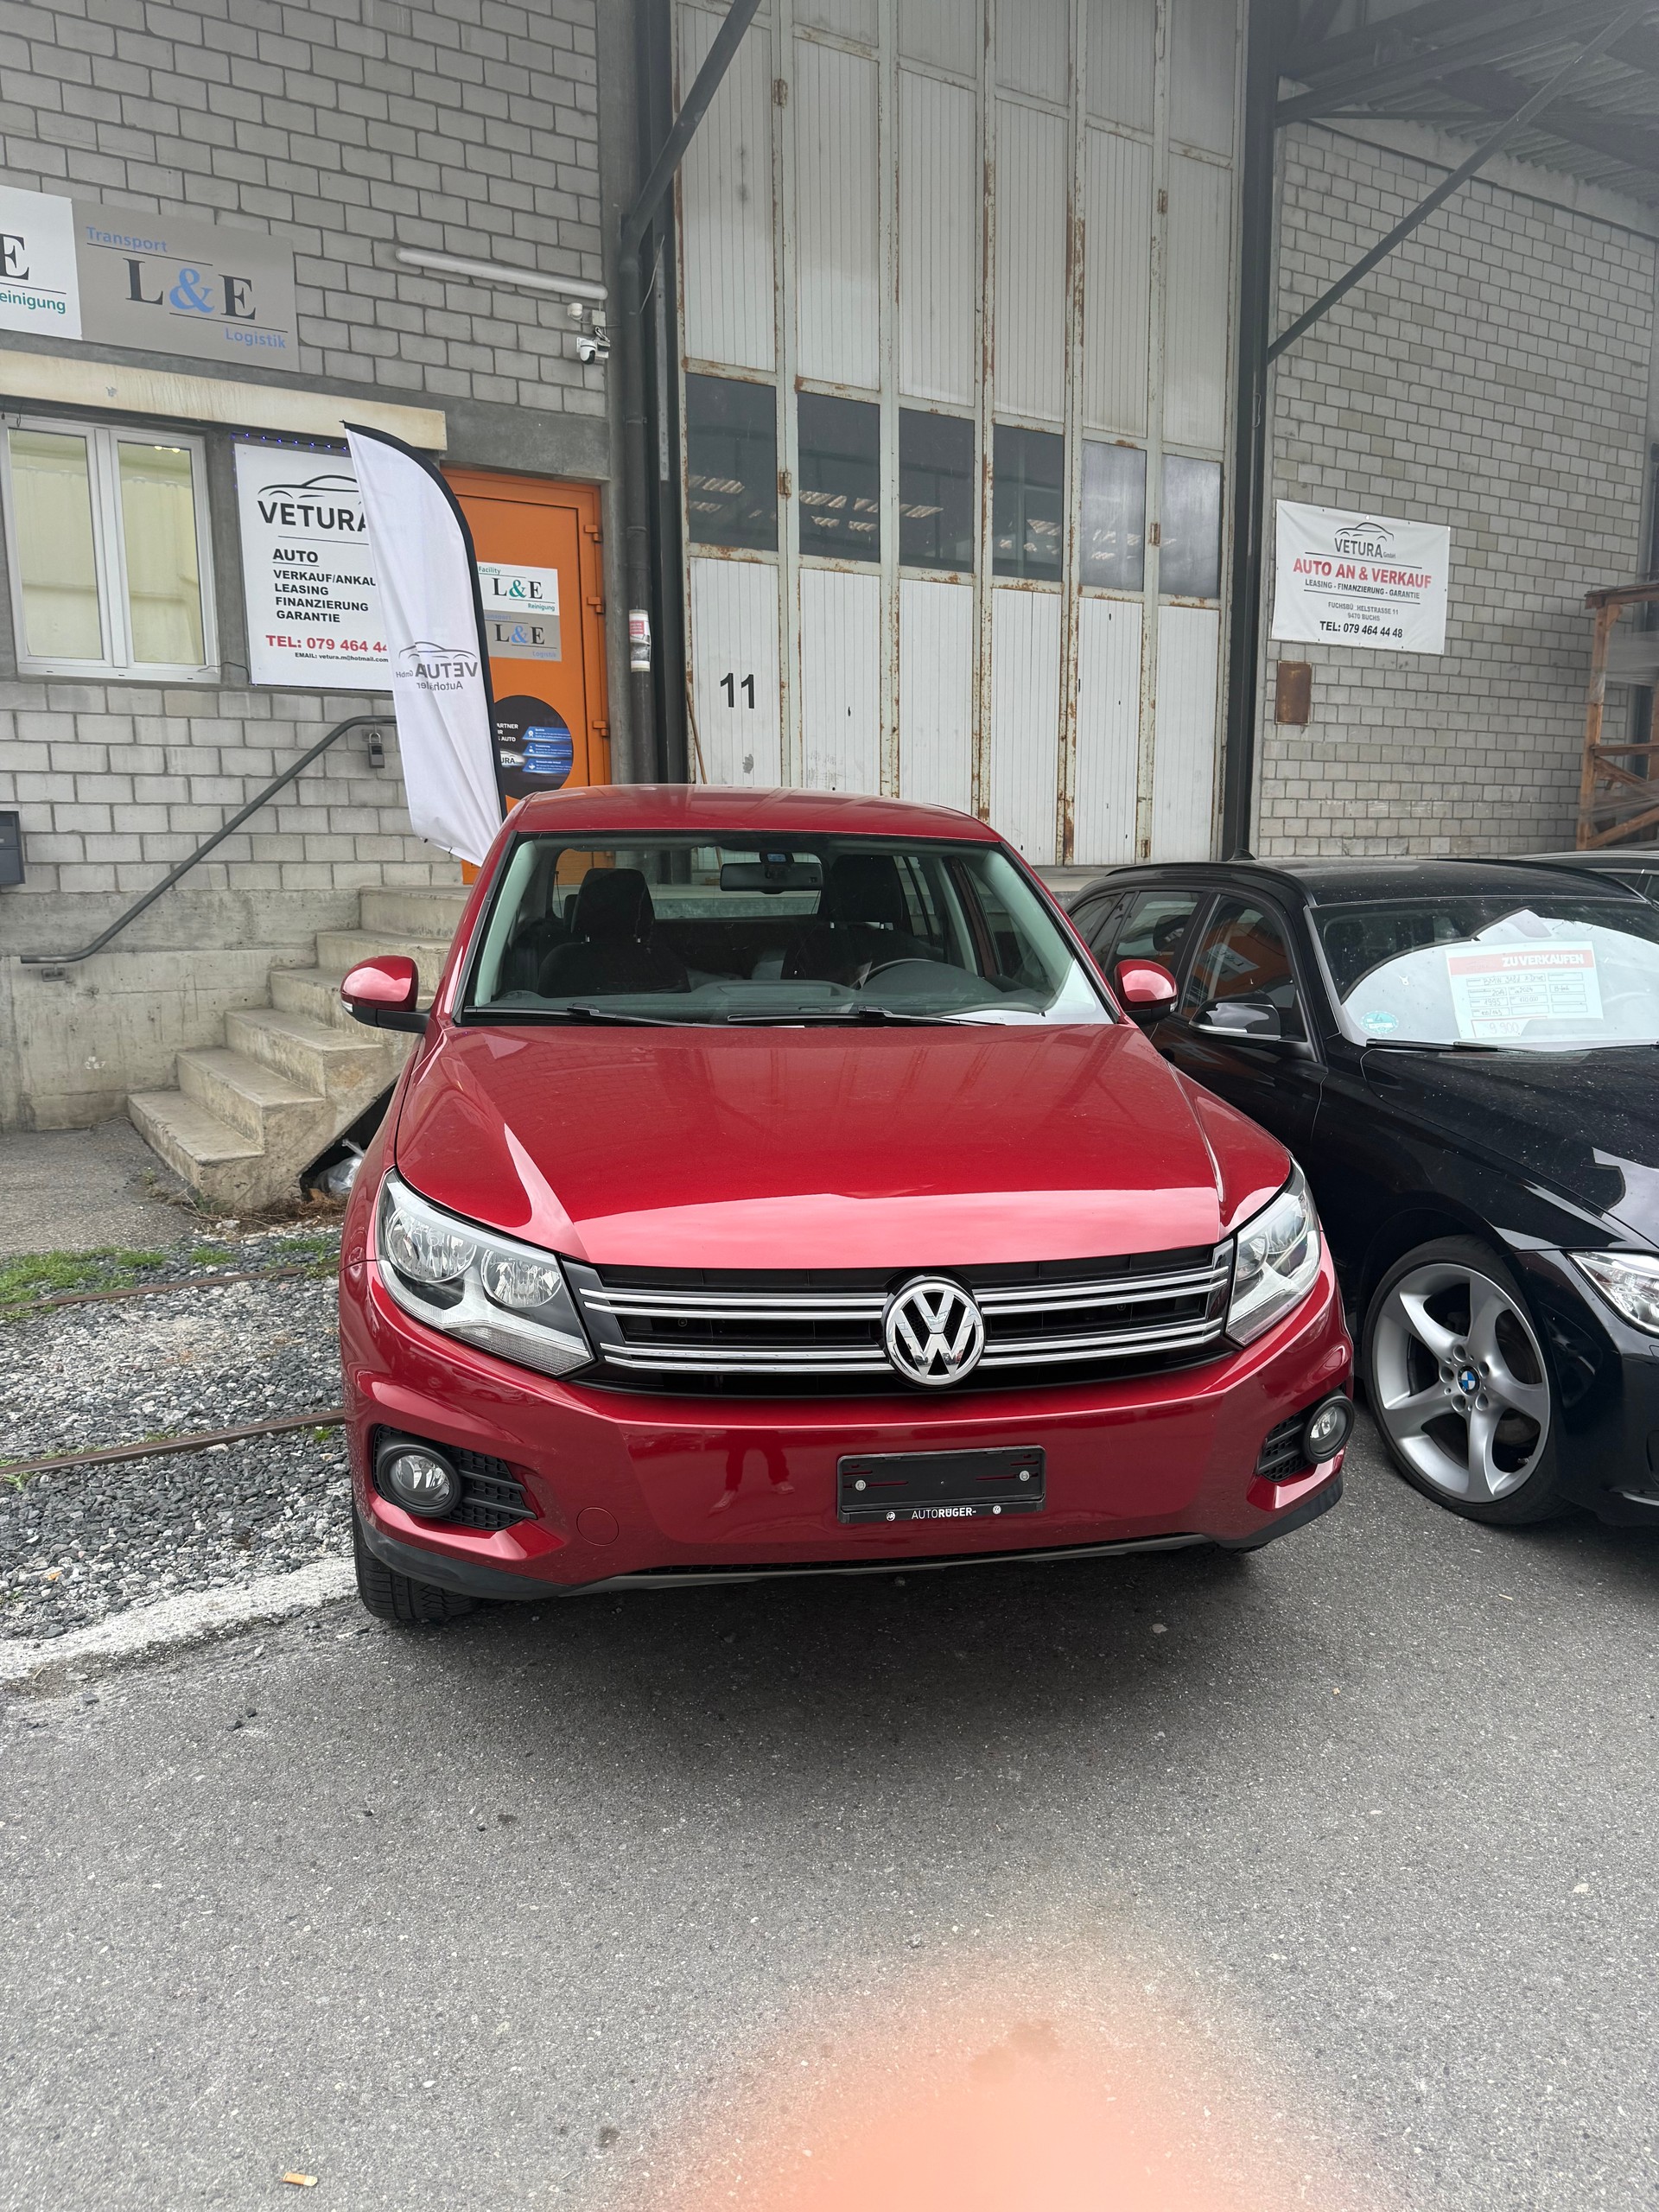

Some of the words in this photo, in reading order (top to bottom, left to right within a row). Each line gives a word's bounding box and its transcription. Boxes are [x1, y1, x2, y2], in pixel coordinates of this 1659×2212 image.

[86, 226, 168, 253] Transport
[0, 289, 66, 315] einigung
[226, 327, 286, 348] Logistik
[272, 548, 319, 563] AUTO
[1334, 537, 1382, 558] VETURA
[479, 566, 501, 575] Facility
[1293, 558, 1332, 575] AUTO
[1336, 563, 1356, 580] AN
[1358, 567, 1369, 581] &
[1372, 568, 1432, 588] VERKAUF
[275, 583, 328, 596] LEASING
[1305, 579, 1332, 589] LEASING
[1338, 582, 1384, 595] FINANZIERUNG
[1389, 589, 1421, 600] GARANTIE
[275, 596, 369, 612] FINANZIERUNG
[528, 602, 556, 612] Reinigung
[276, 610, 340, 623] GARANTIE
[1319, 620, 1341, 632] TEL:
[1343, 622, 1360, 634] 079
[1362, 626, 1377, 636] 464
[1379, 626, 1391, 637] 44
[1392, 628, 1403, 638] 48
[265, 634, 302, 648] TEL:
[306, 638, 335, 650] 079
[340, 639, 368, 652] 464
[721, 672, 755, 709] 11
[1502, 957, 1518, 968] ZU
[1519, 953, 1585, 966] VERKAUFEN
